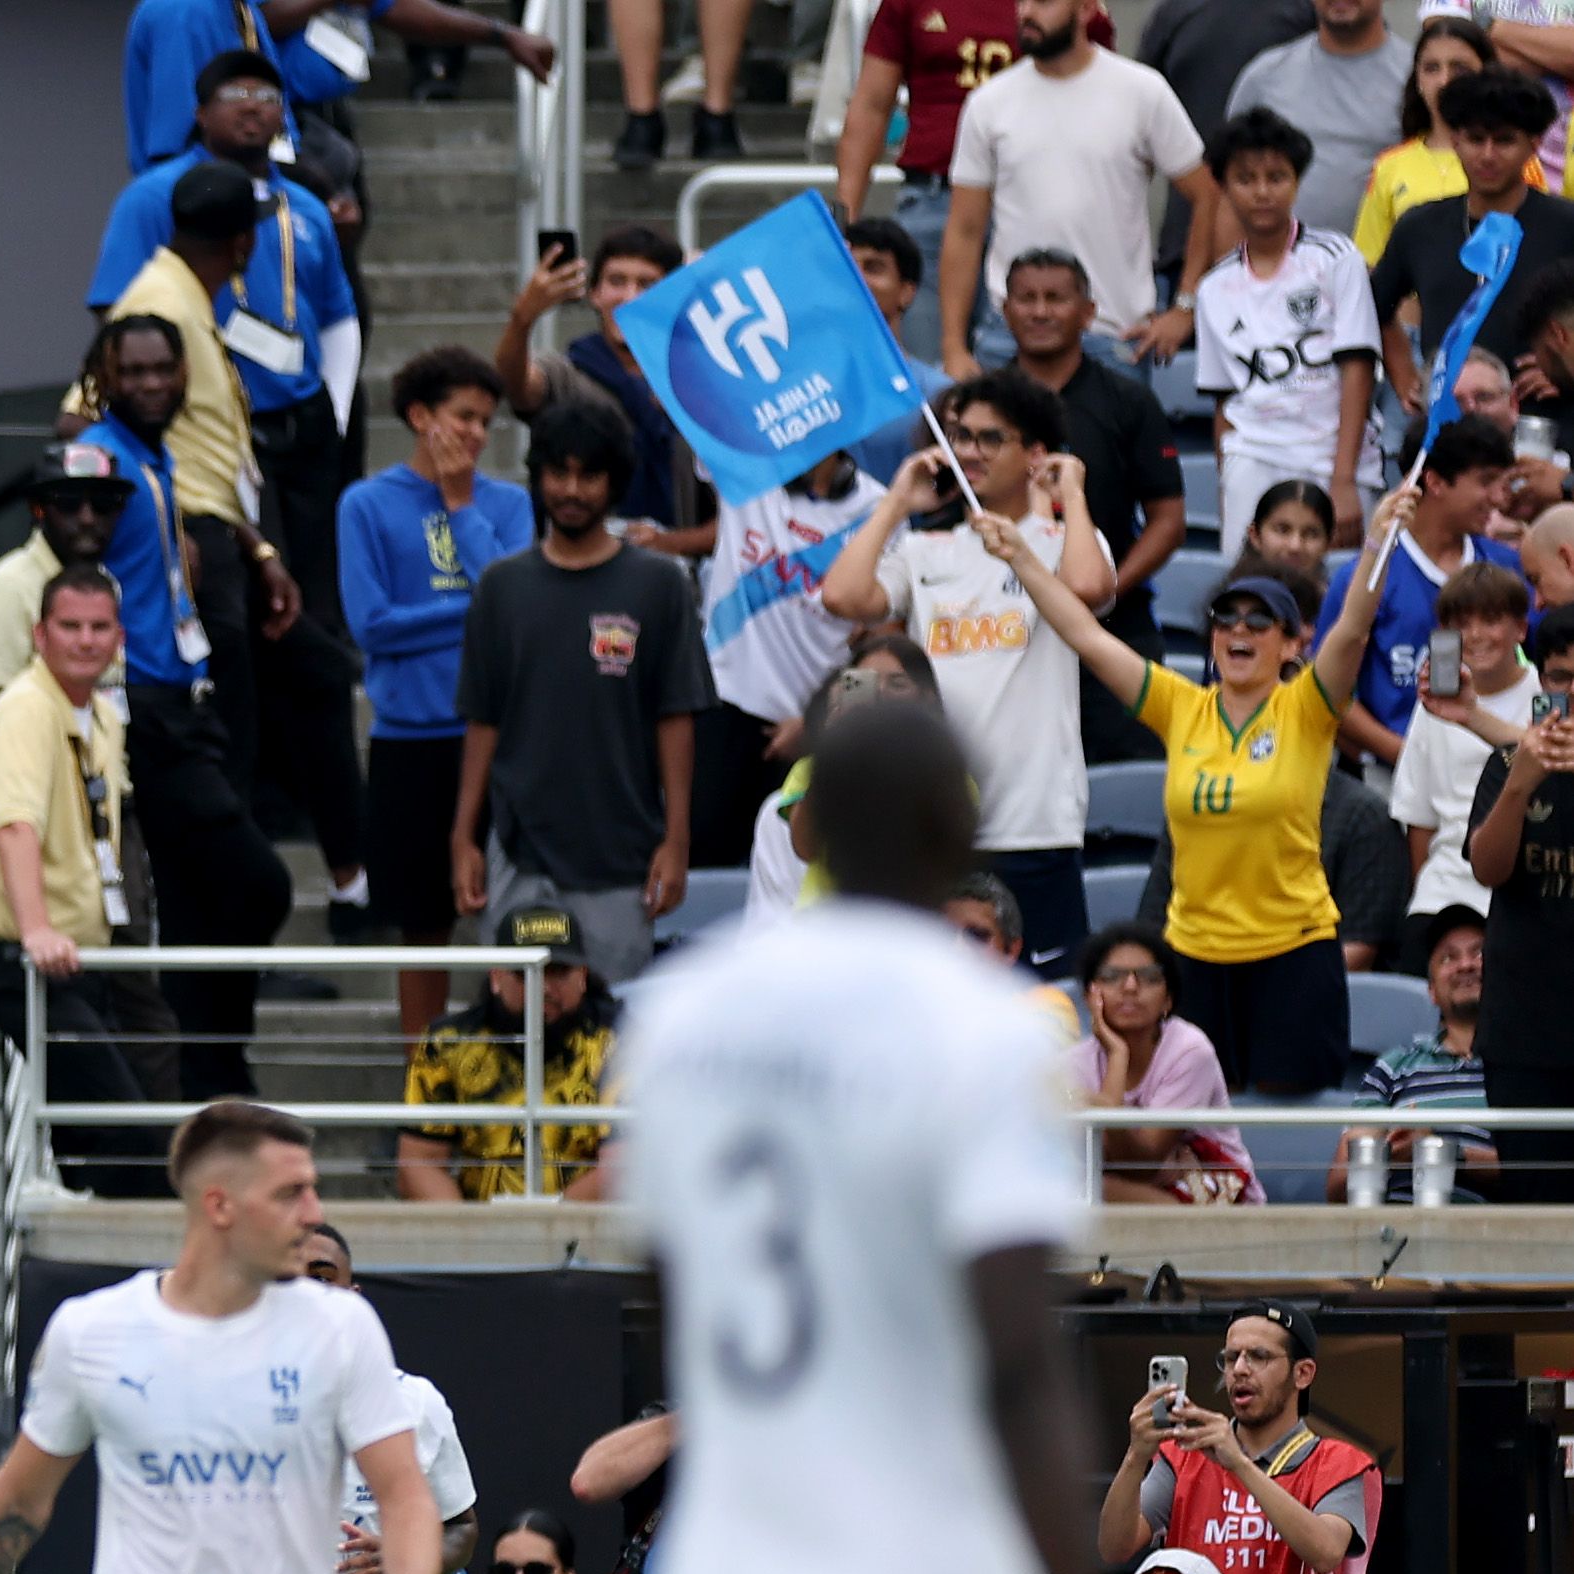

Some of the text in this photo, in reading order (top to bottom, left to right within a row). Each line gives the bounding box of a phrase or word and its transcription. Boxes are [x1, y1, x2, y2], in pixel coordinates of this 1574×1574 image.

[927, 610, 1029, 656] BMG
[712, 1123, 822, 1403] 3
[138, 1452, 286, 1486] SAVVY
